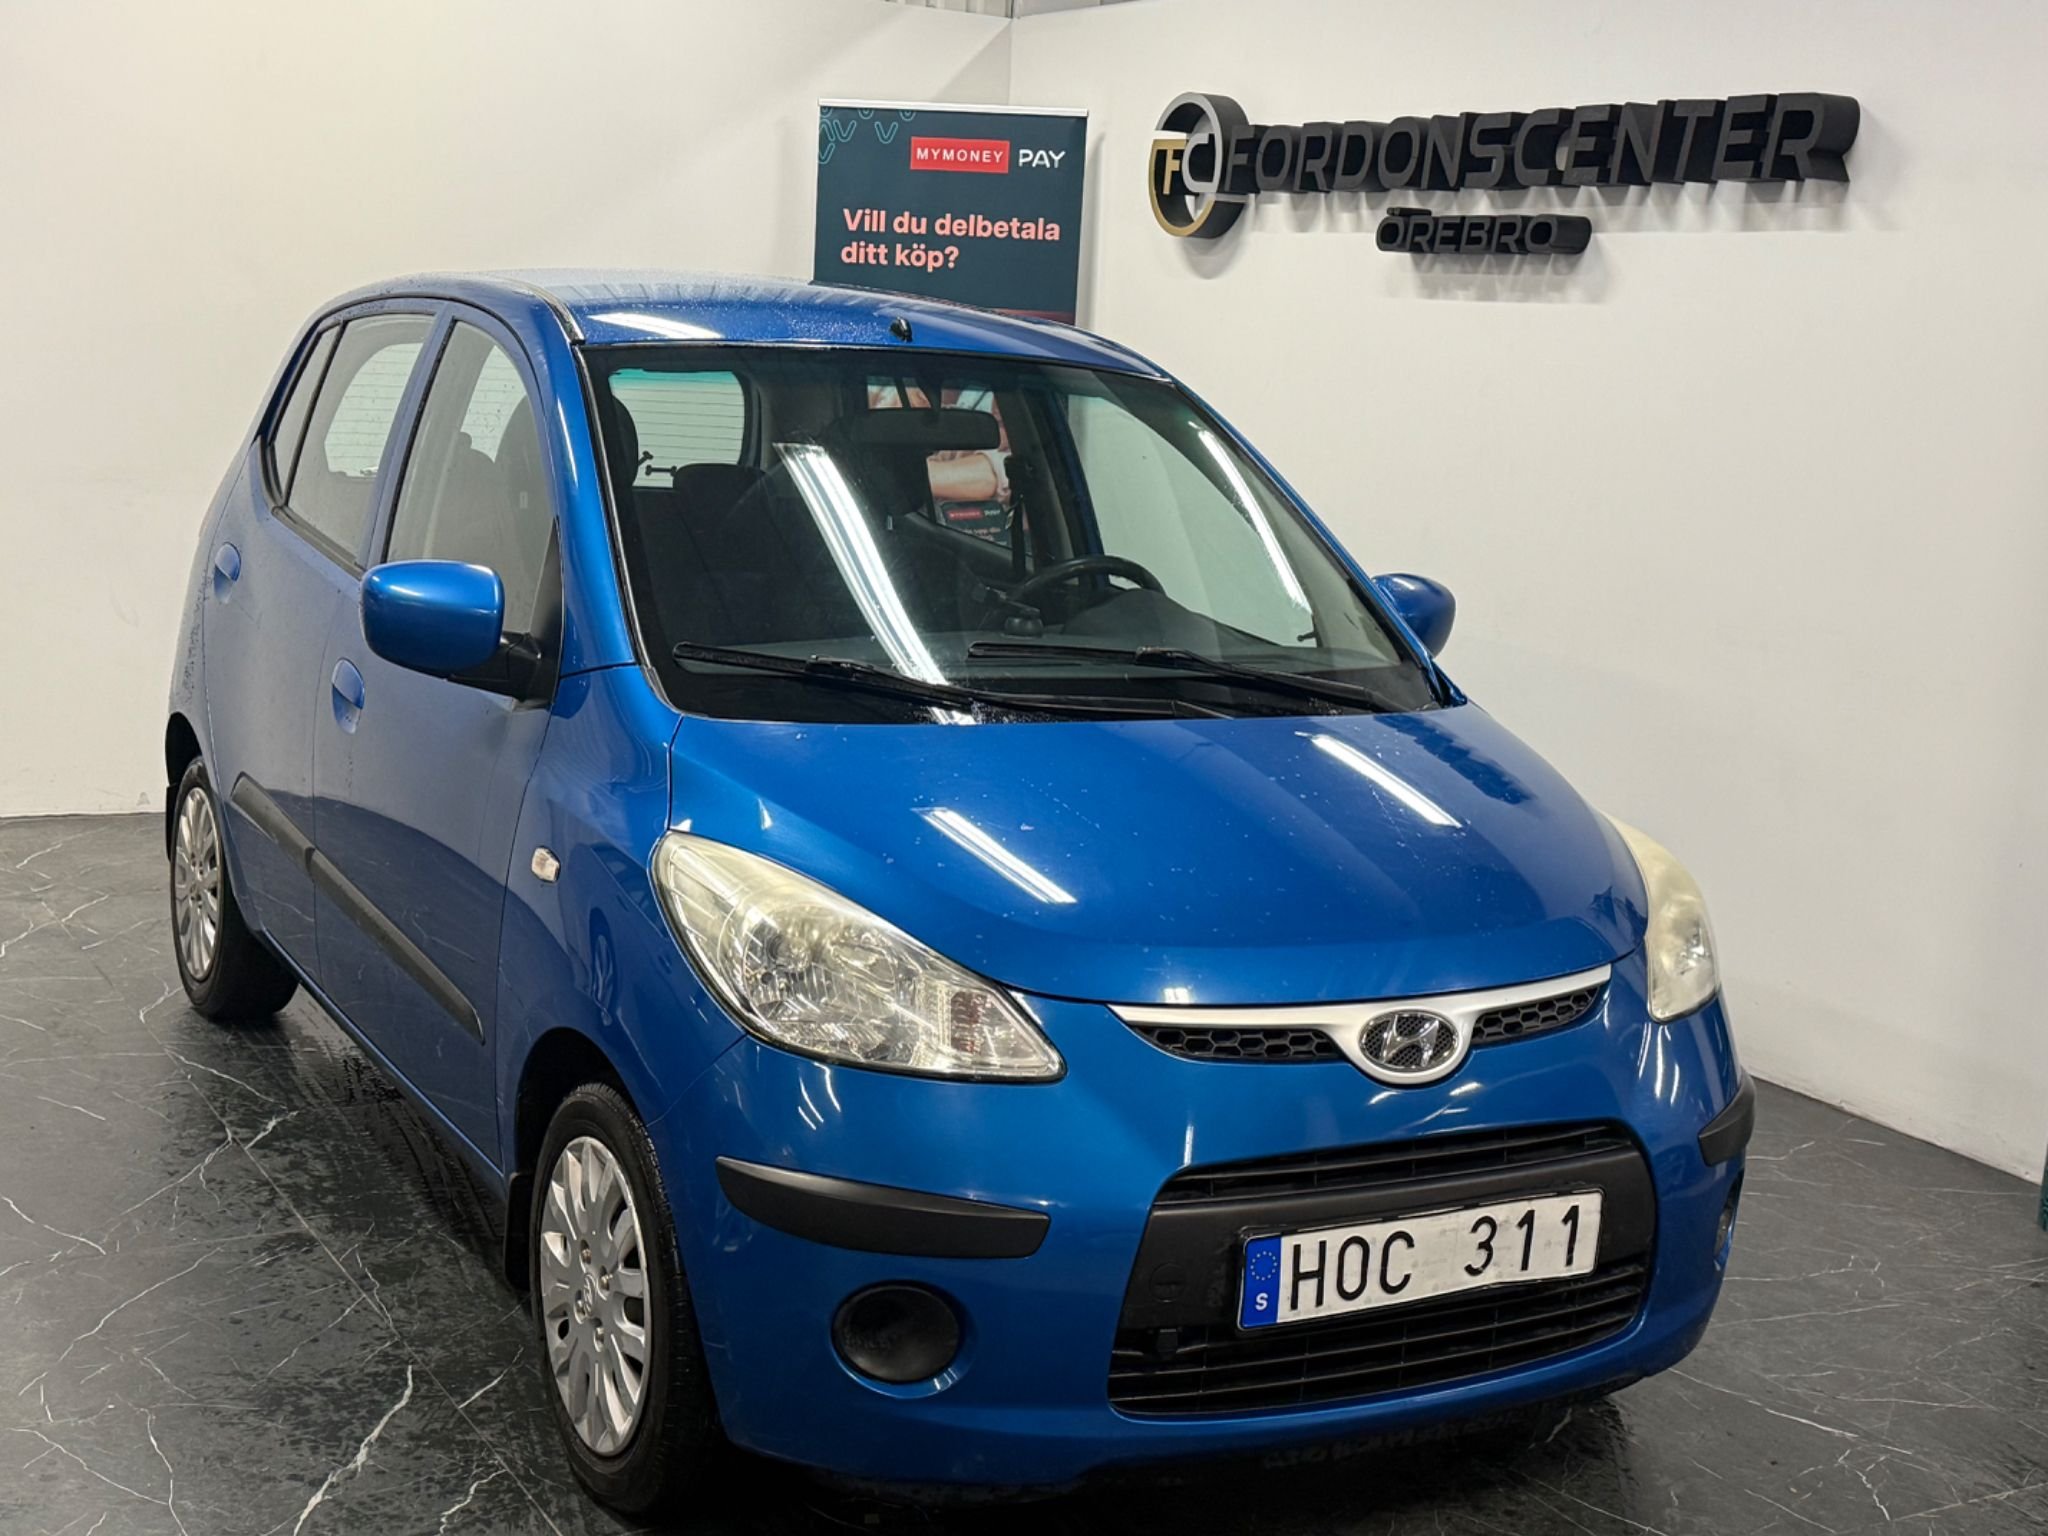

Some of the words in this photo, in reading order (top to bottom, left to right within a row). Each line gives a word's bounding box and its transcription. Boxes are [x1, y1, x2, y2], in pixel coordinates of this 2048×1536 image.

[915, 147, 1004, 164] MYMONEY
[1018, 149, 1066, 169] PAY
[1223, 92, 1832, 193] FORDONSCENTER
[842, 208, 887, 233] Vill
[892, 211, 928, 235] du
[934, 213, 1062, 241] delbetala
[1376, 207, 1562, 254] ÖREBRO
[840, 241, 888, 266] ditt
[894, 243, 960, 273] köp?
[1289, 1230, 1416, 1311] HOC
[1463, 1204, 1580, 1277] 311
[1254, 1292, 1269, 1312] S
